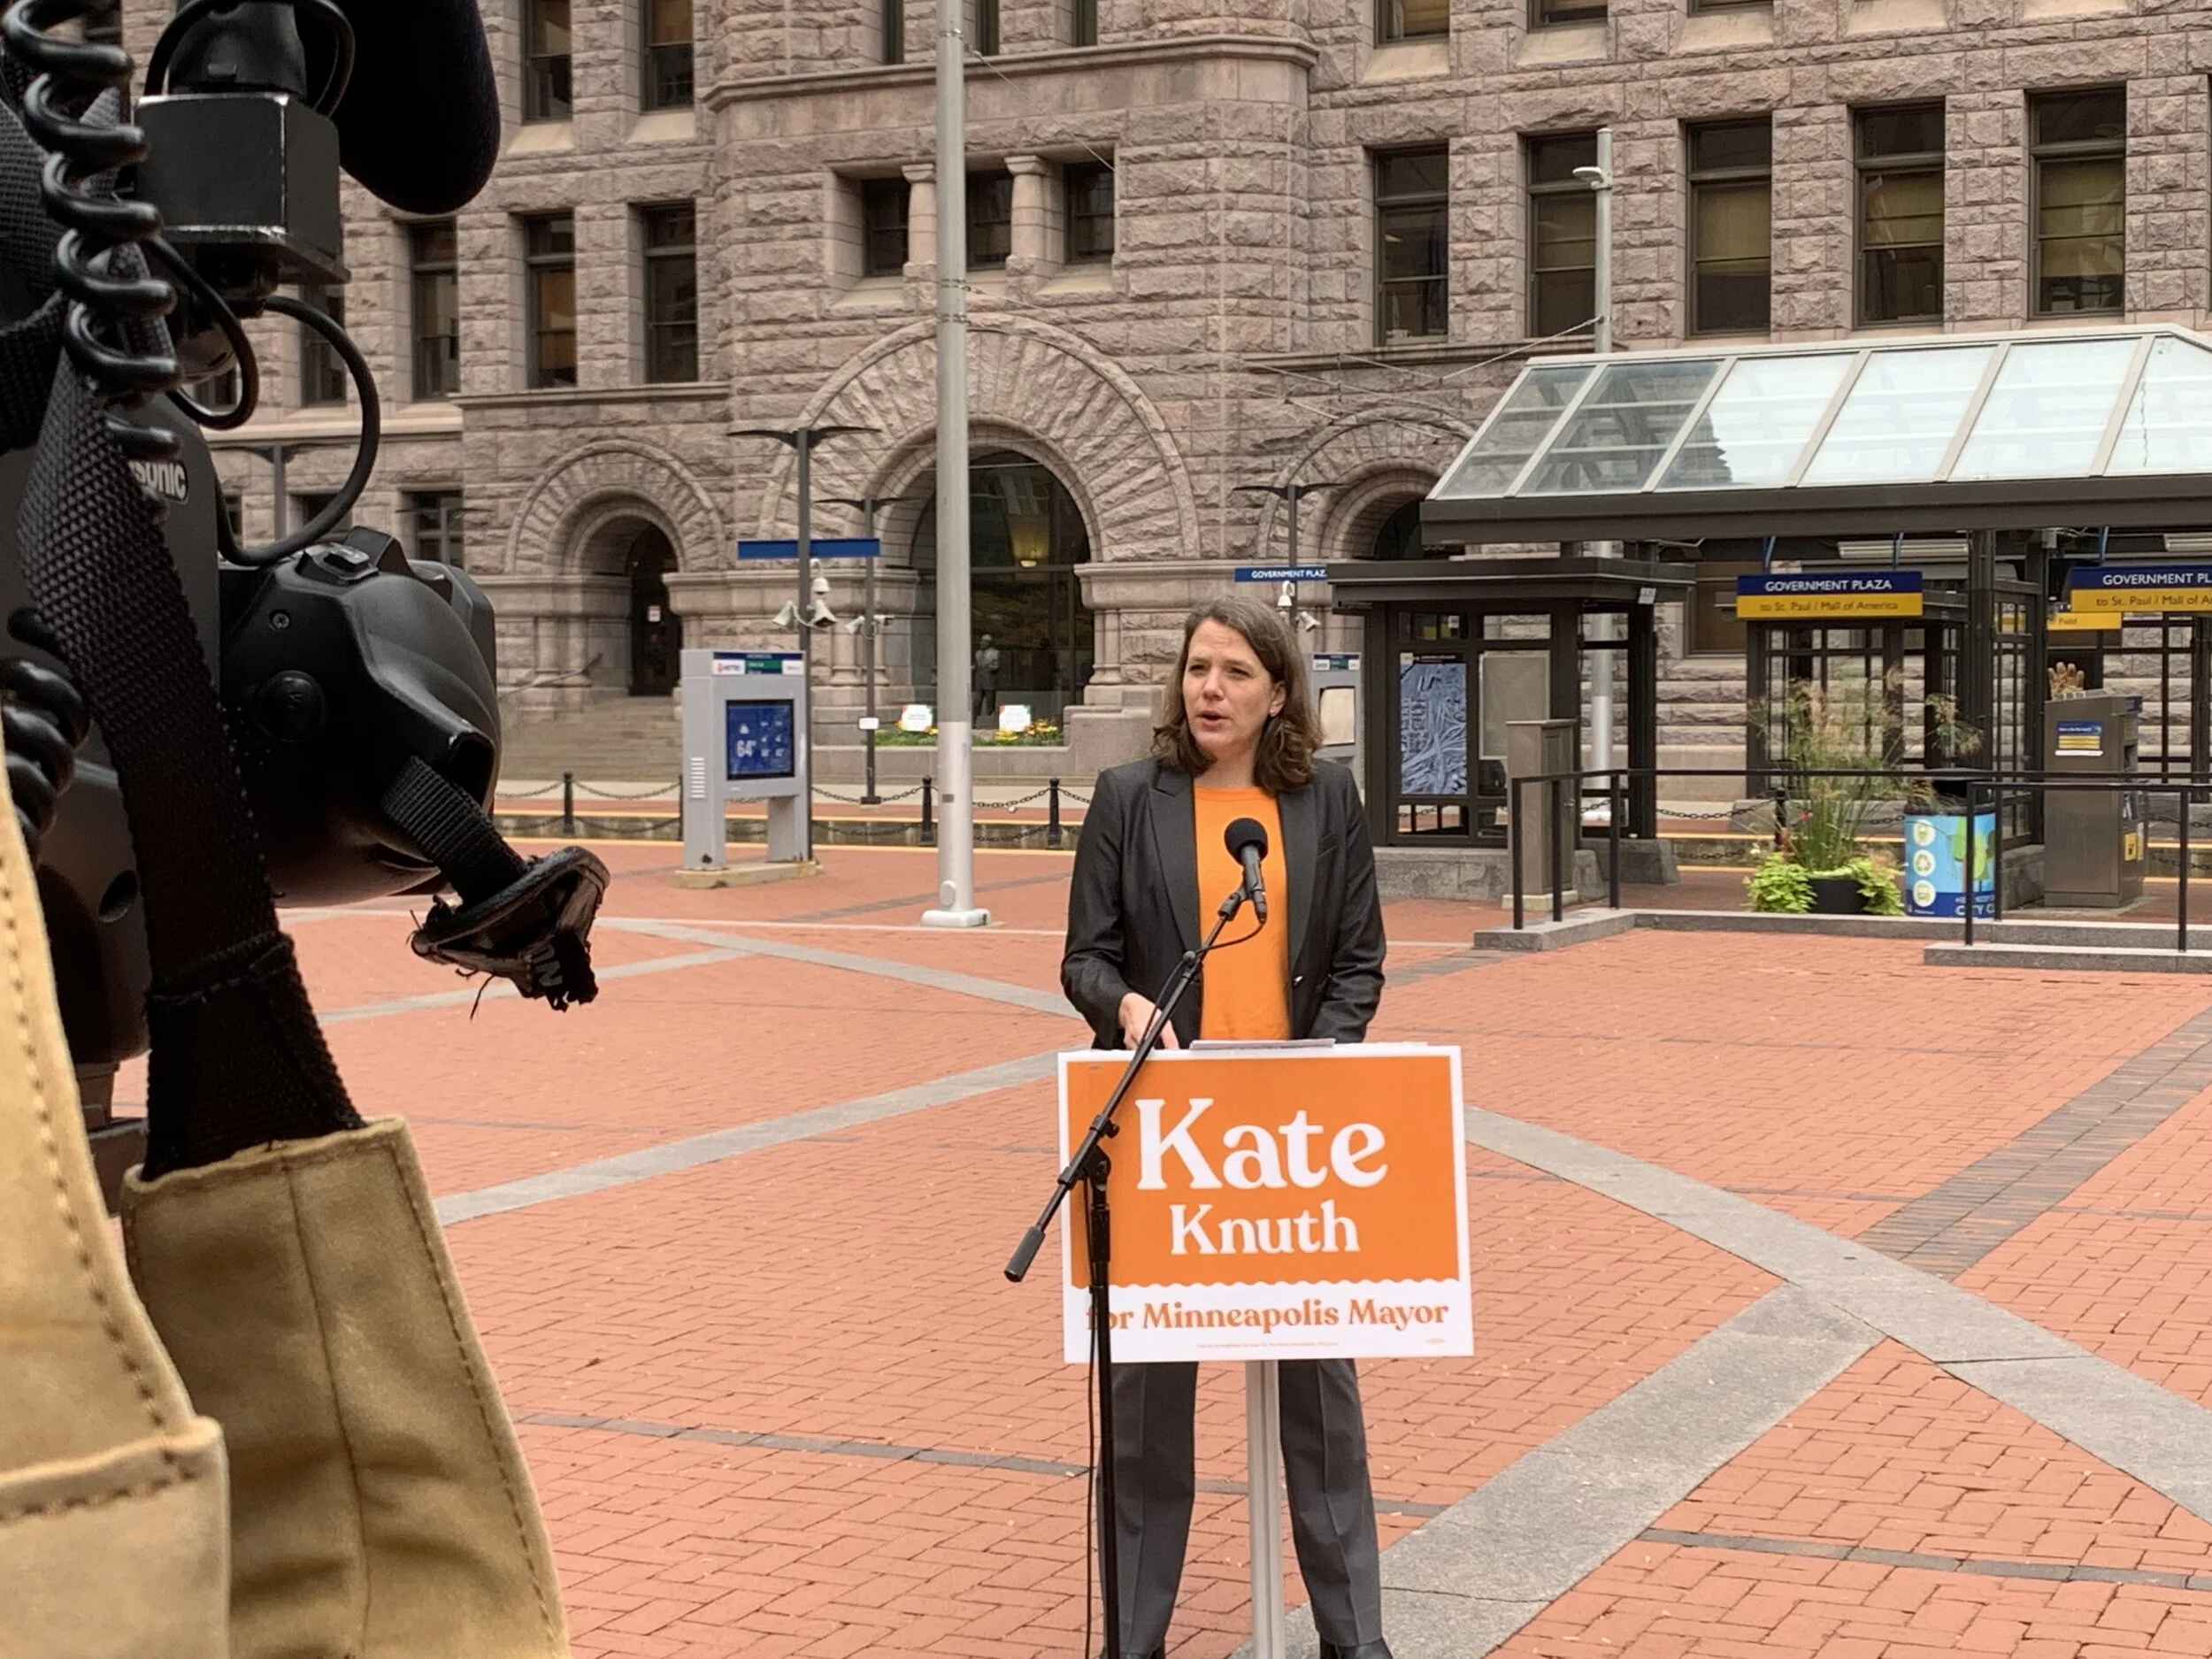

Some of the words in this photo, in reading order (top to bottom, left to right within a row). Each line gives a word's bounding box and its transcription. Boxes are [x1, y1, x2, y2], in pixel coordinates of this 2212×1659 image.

[1251, 570, 1304, 579] GOVERNMENT
[1305, 569, 1327, 578] PLAZ
[2102, 573, 2193, 585] GOVERNMENT
[1765, 580, 1847, 592] GOVERNMENT
[1851, 580, 1892, 590] PLAZA
[2130, 595, 2151, 605] Paul
[2162, 595, 2185, 604] Mall
[2187, 594, 2198, 603] of
[1791, 602, 1810, 611] Paul
[1821, 601, 1841, 610] Mall
[1857, 601, 1899, 610] America
[1135, 1097, 1387, 1191] Kate
[1169, 1199, 1361, 1255] Knuth
[1143, 1299, 1340, 1334] Minneapolis
[1348, 1298, 1449, 1332] Mayor
